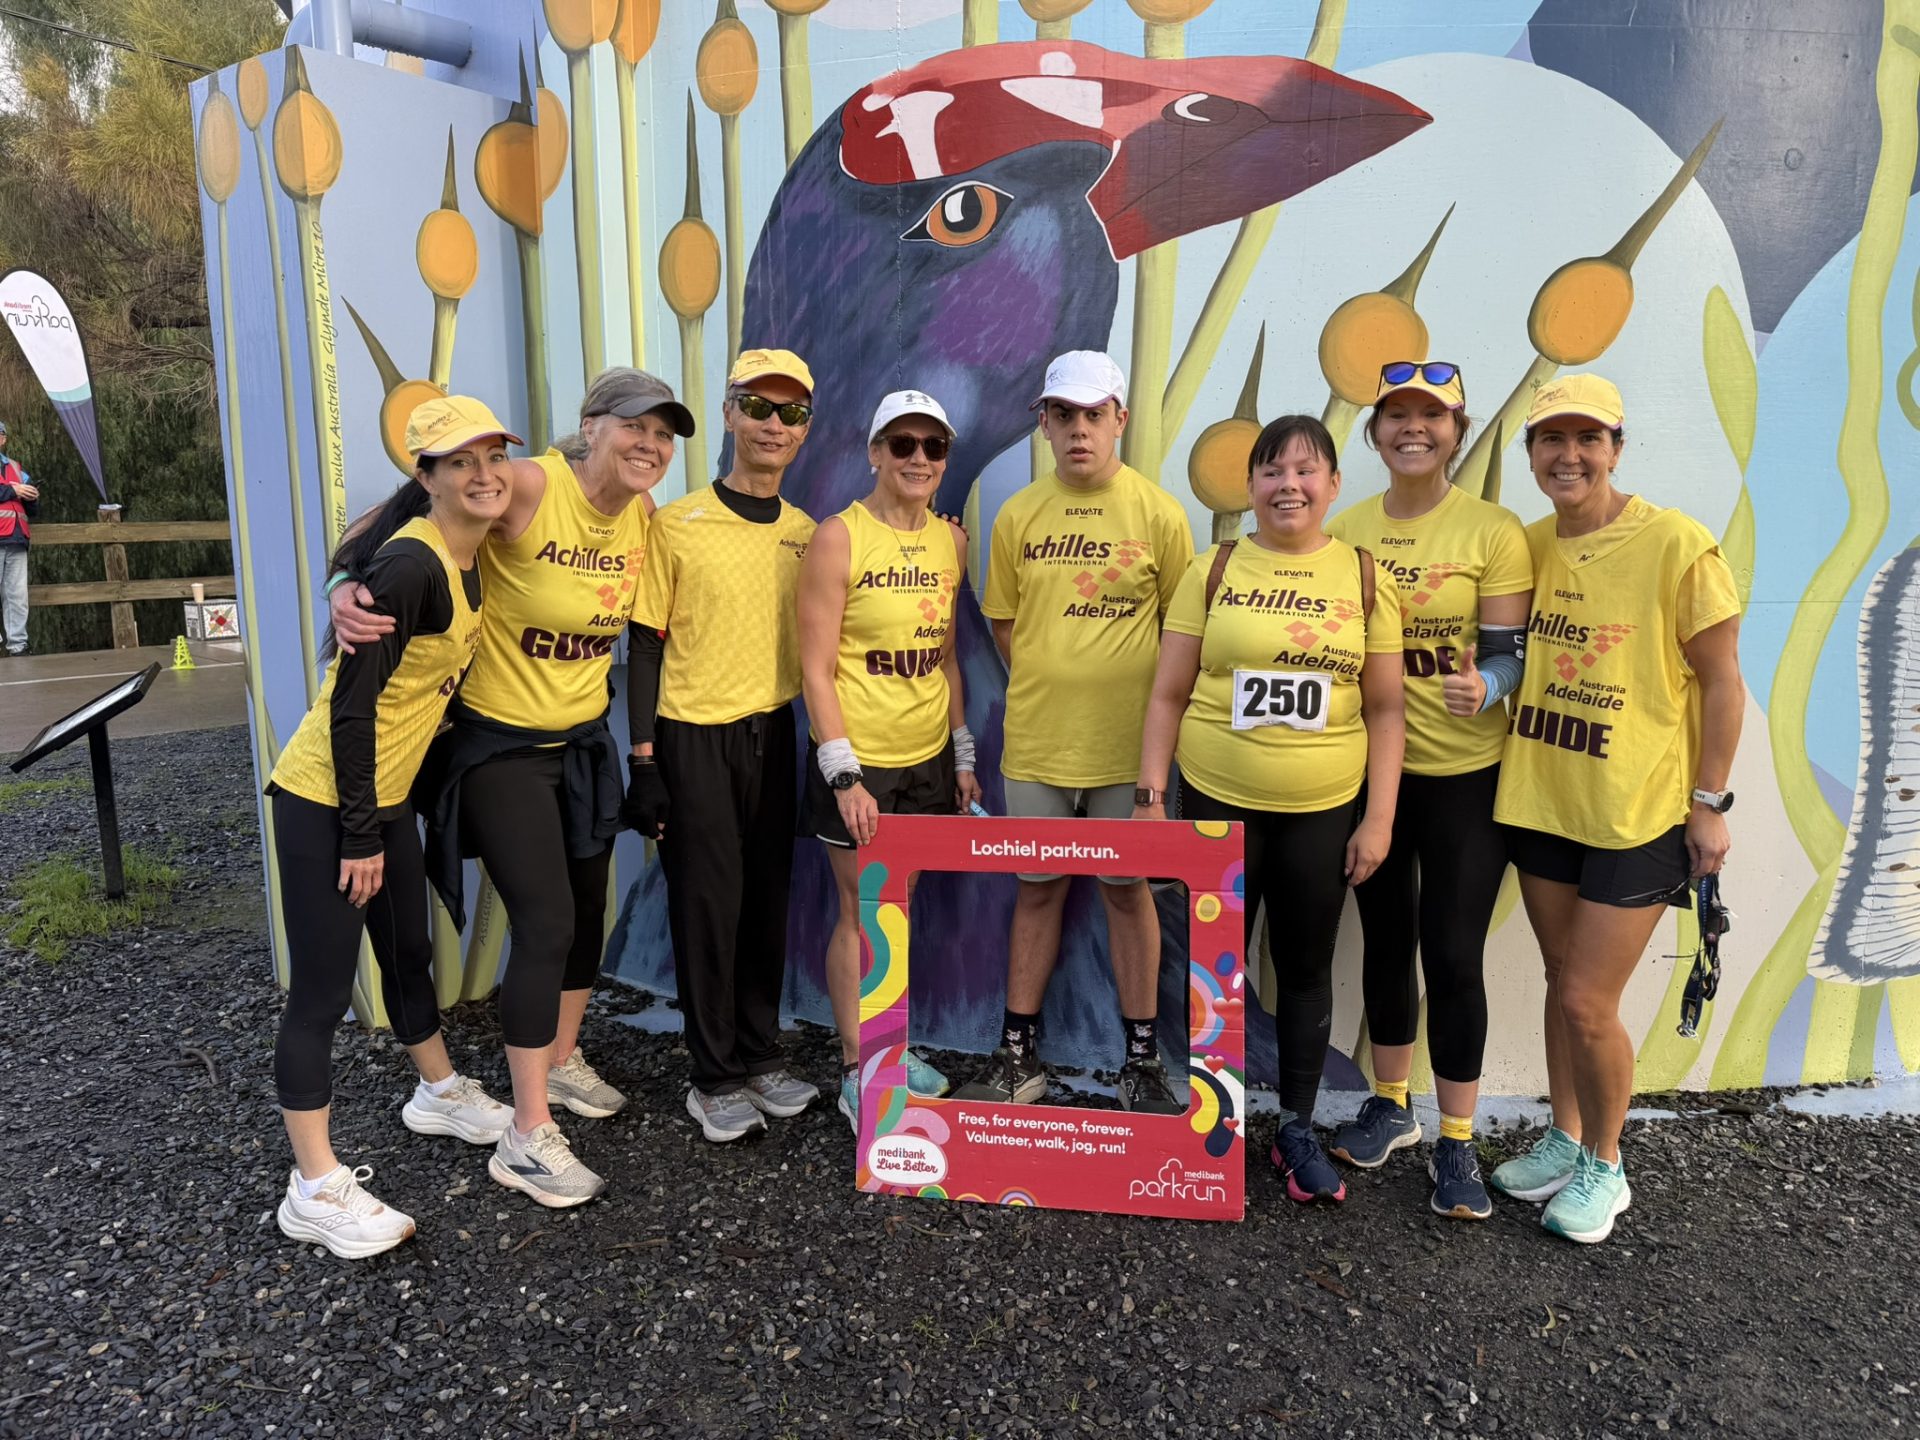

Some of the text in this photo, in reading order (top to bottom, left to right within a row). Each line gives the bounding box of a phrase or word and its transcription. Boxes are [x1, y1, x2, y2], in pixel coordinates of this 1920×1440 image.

[312, 221, 323, 244] 10
[312, 245, 328, 290] Mitre
[316, 294, 338, 355] Glynde
[322, 363, 341, 440] Australia
[331, 443, 344, 488] Dulux
[1066, 508, 1103, 516] ELEVATE
[1024, 534, 1112, 563] Achilles
[1381, 537, 1416, 546] ELEVATE
[535, 541, 625, 571] Achilles
[573, 571, 624, 579] INTERNATIONAL
[856, 566, 939, 589] Achilles
[1274, 570, 1314, 578] ELEVATE
[1218, 587, 1328, 613] Achilles
[1554, 589, 1585, 601] ELEVATE
[1251, 609, 1326, 619] INTERNATIONAL
[1413, 615, 1464, 624] Australia
[1529, 610, 1590, 644] hilles
[1534, 636, 1585, 652] INTERNATIONAL
[1273, 651, 1358, 675] Adelaide
[1544, 683, 1624, 711] Adelaide
[1579, 679, 1626, 694] Australia
[1243, 677, 1322, 720] 250
[971, 839, 1119, 861] Lochiel parkrun.
[958, 1112, 1134, 1136] Free, for everyone, forever.
[877, 1147, 926, 1159] medibank
[965, 1130, 1126, 1154] Volunteer, walk, jog, run!
[876, 1158, 938, 1173] Live Better
[1184, 1170, 1225, 1180] medibank
[1129, 1165, 1225, 1202] parkrun
